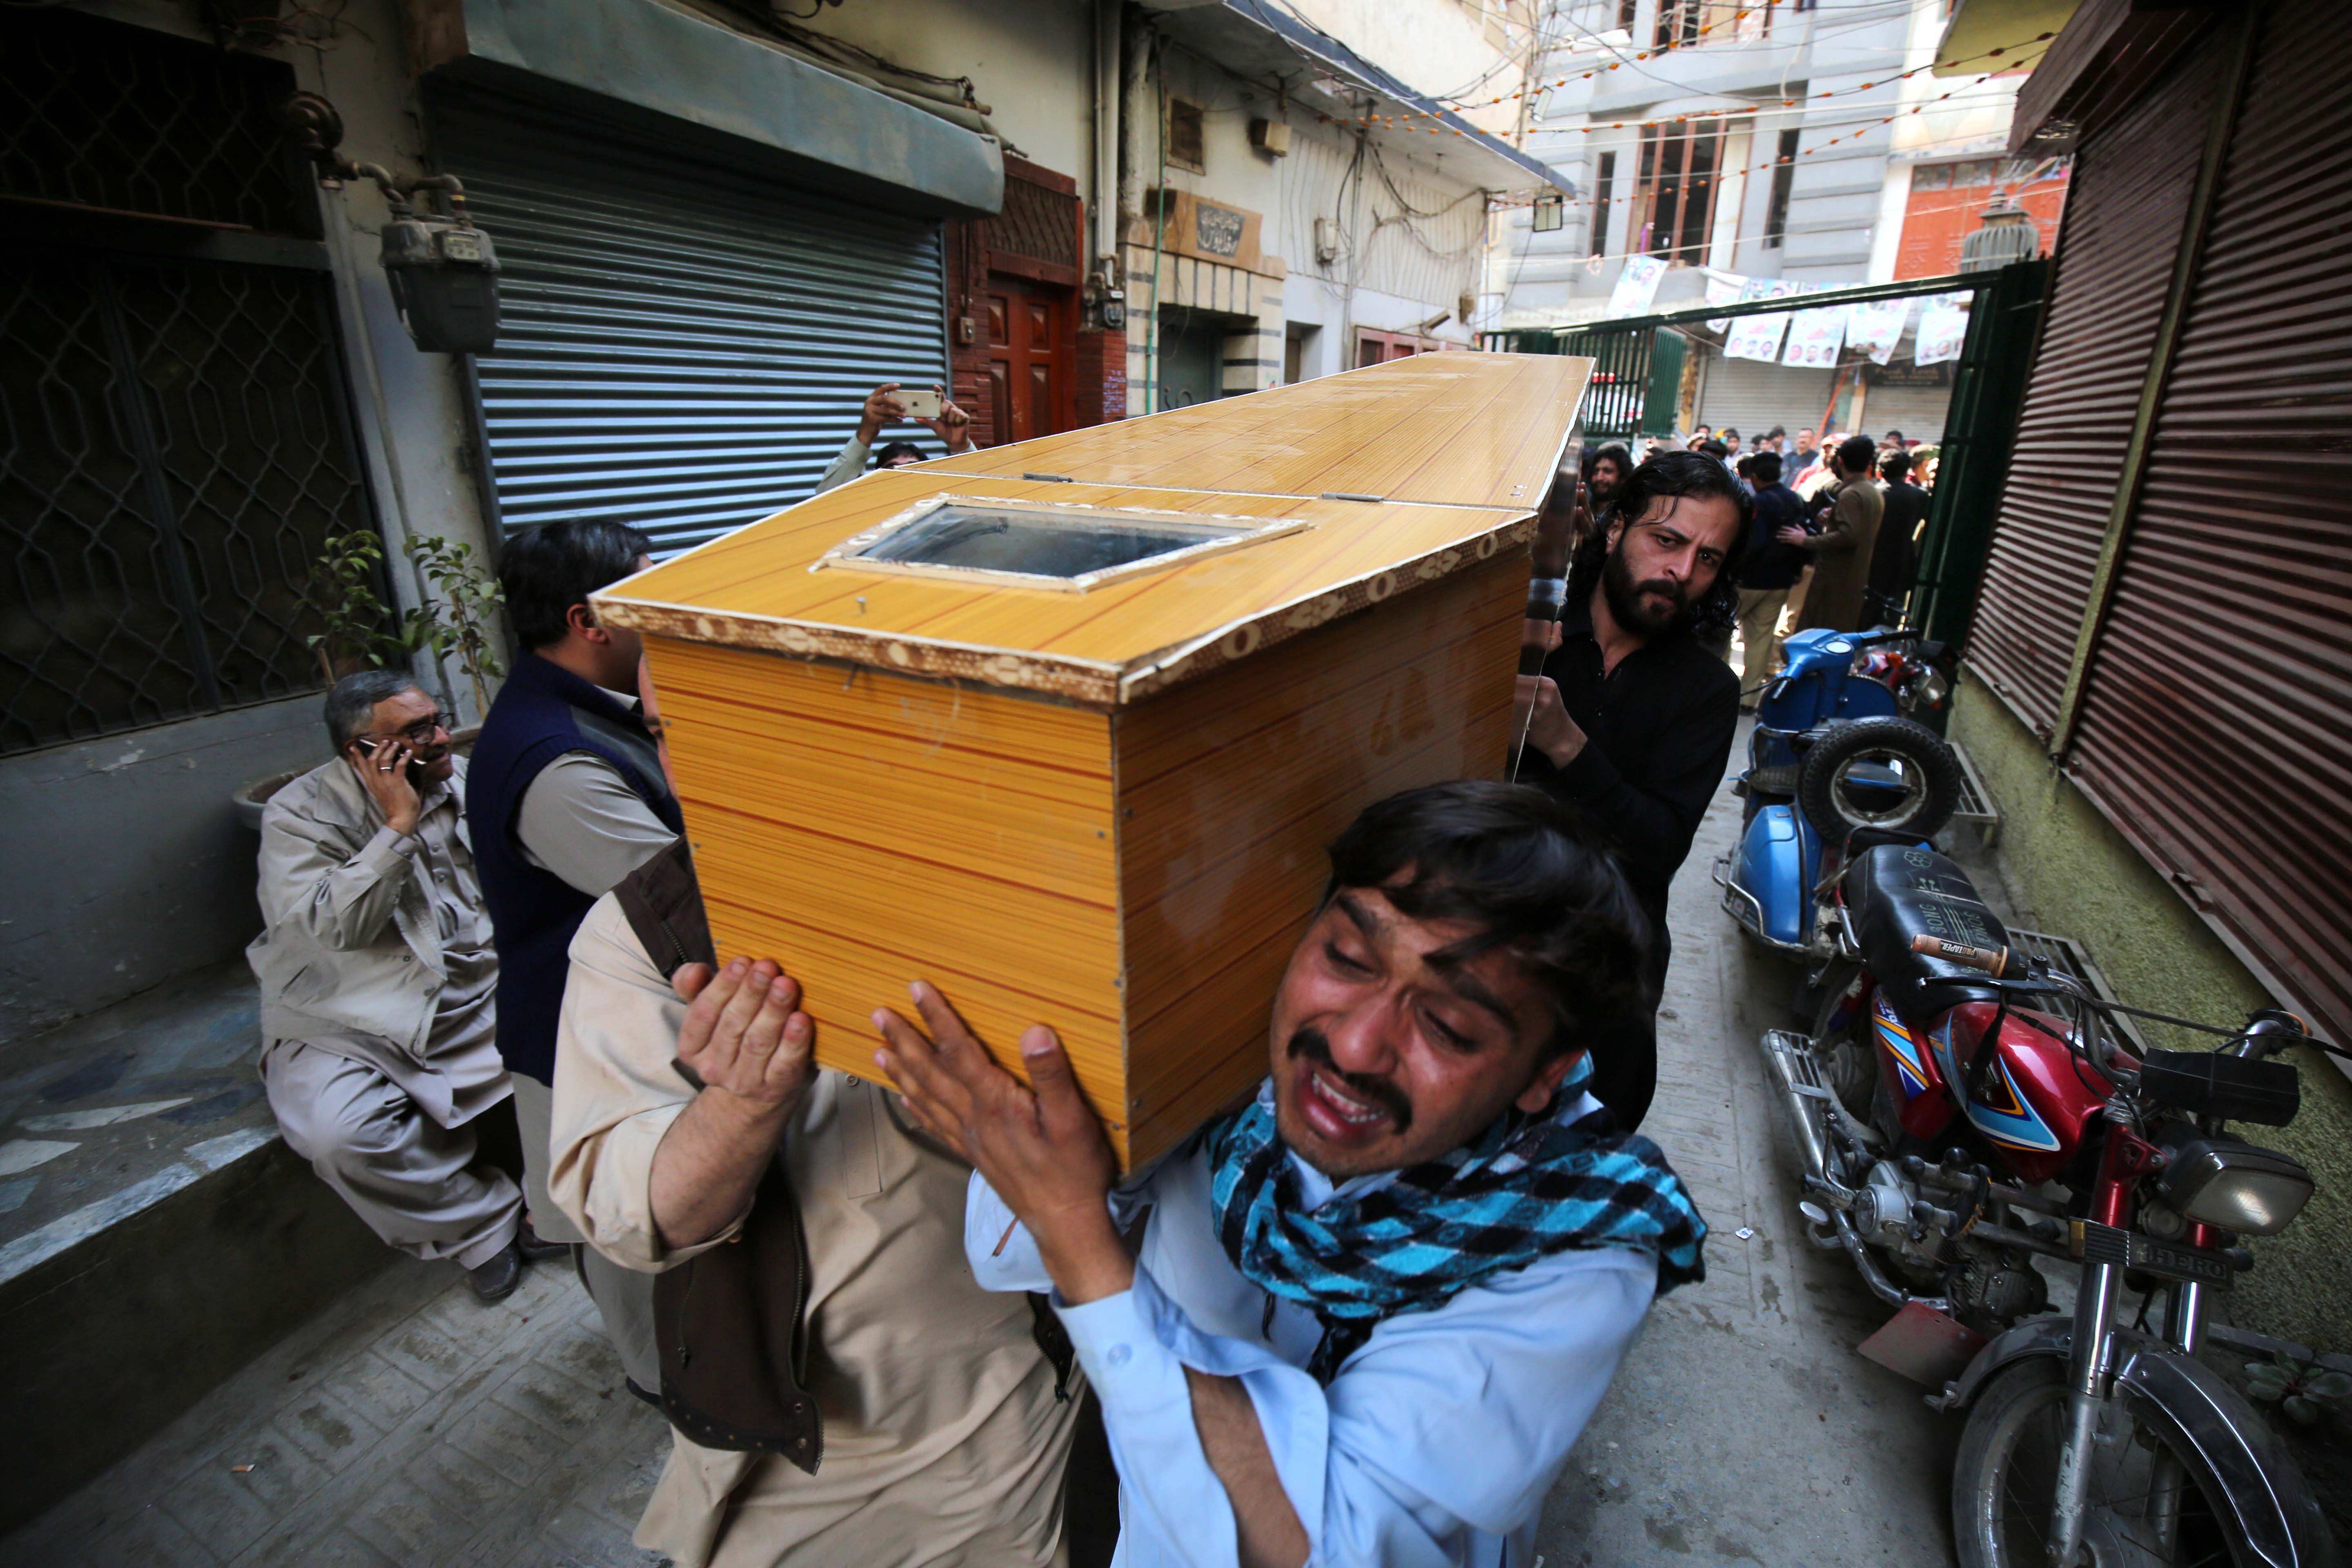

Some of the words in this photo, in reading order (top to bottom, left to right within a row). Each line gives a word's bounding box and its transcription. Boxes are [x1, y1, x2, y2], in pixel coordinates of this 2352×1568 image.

[1920, 904, 1947, 934] SONG
[1942, 942, 1975, 956] PROTAPER
[2151, 1248, 2224, 1276] HERO
